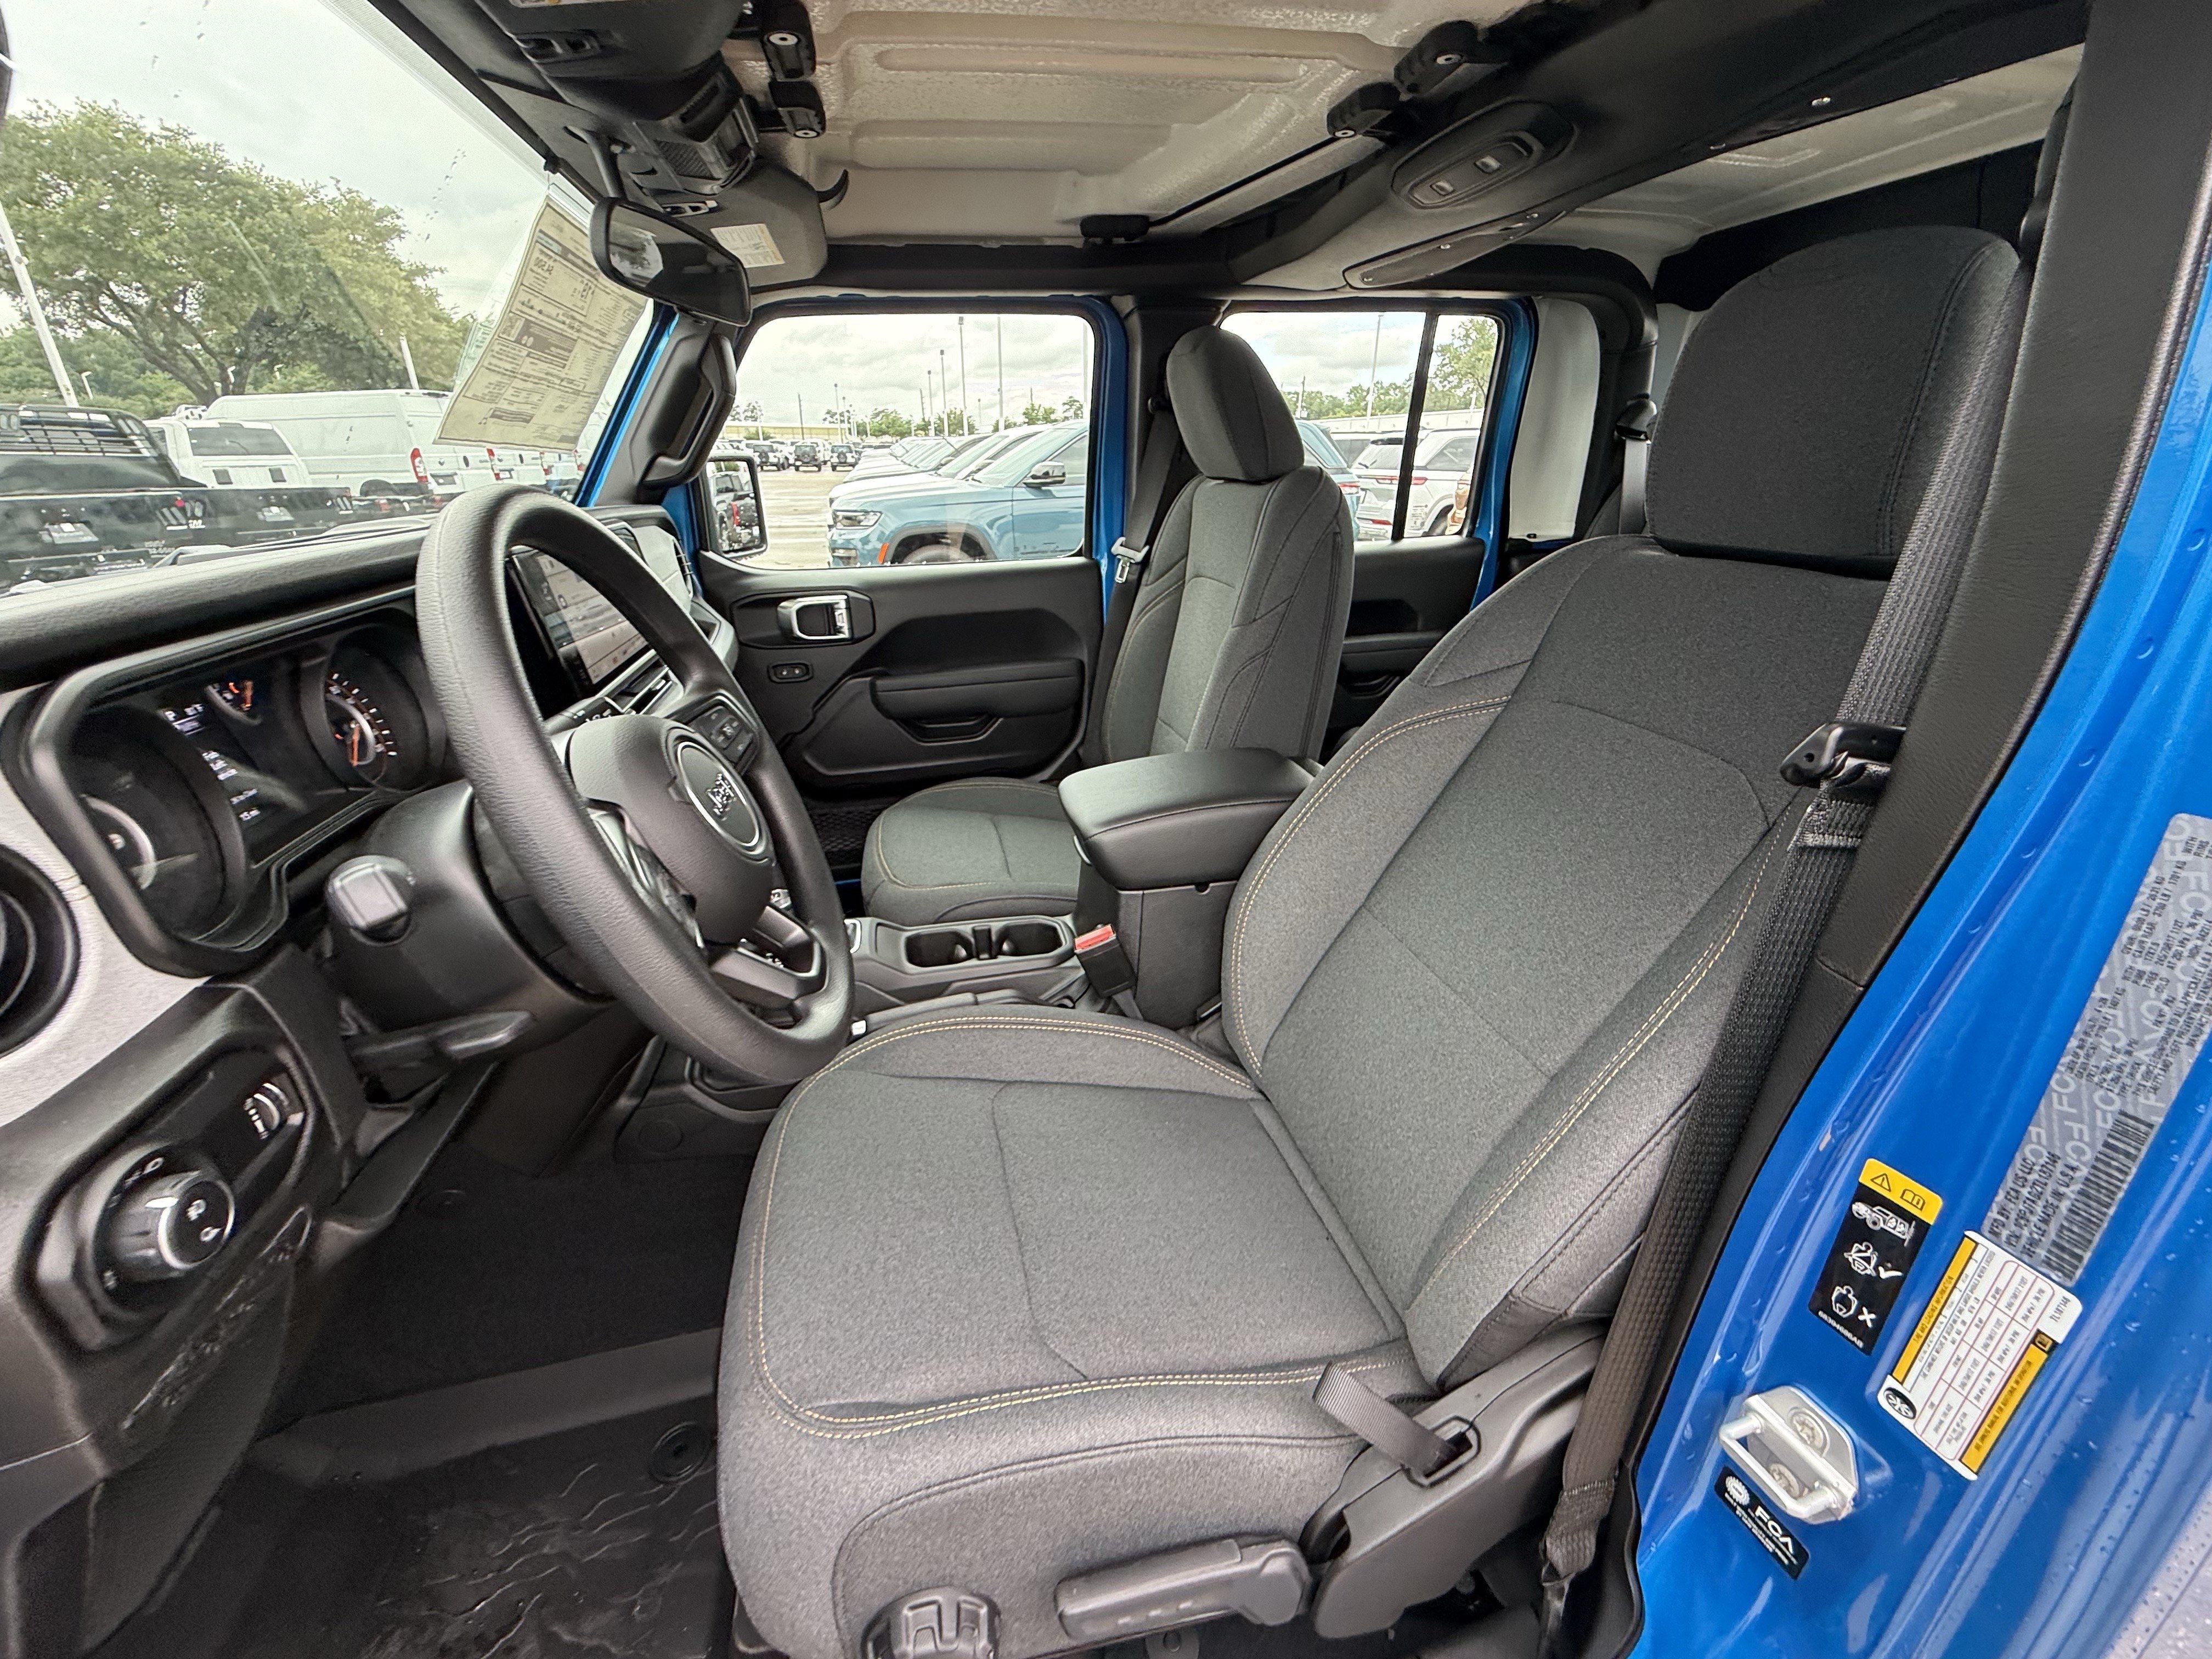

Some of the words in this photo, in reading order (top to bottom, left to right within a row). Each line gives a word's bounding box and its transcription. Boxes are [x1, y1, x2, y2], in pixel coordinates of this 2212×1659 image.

[2018, 1157, 2035, 1174] LLC
[2012, 1173, 2027, 1188] US
[2004, 1187, 2021, 1204] FCA
[1756, 1505, 1795, 1554] FCA
